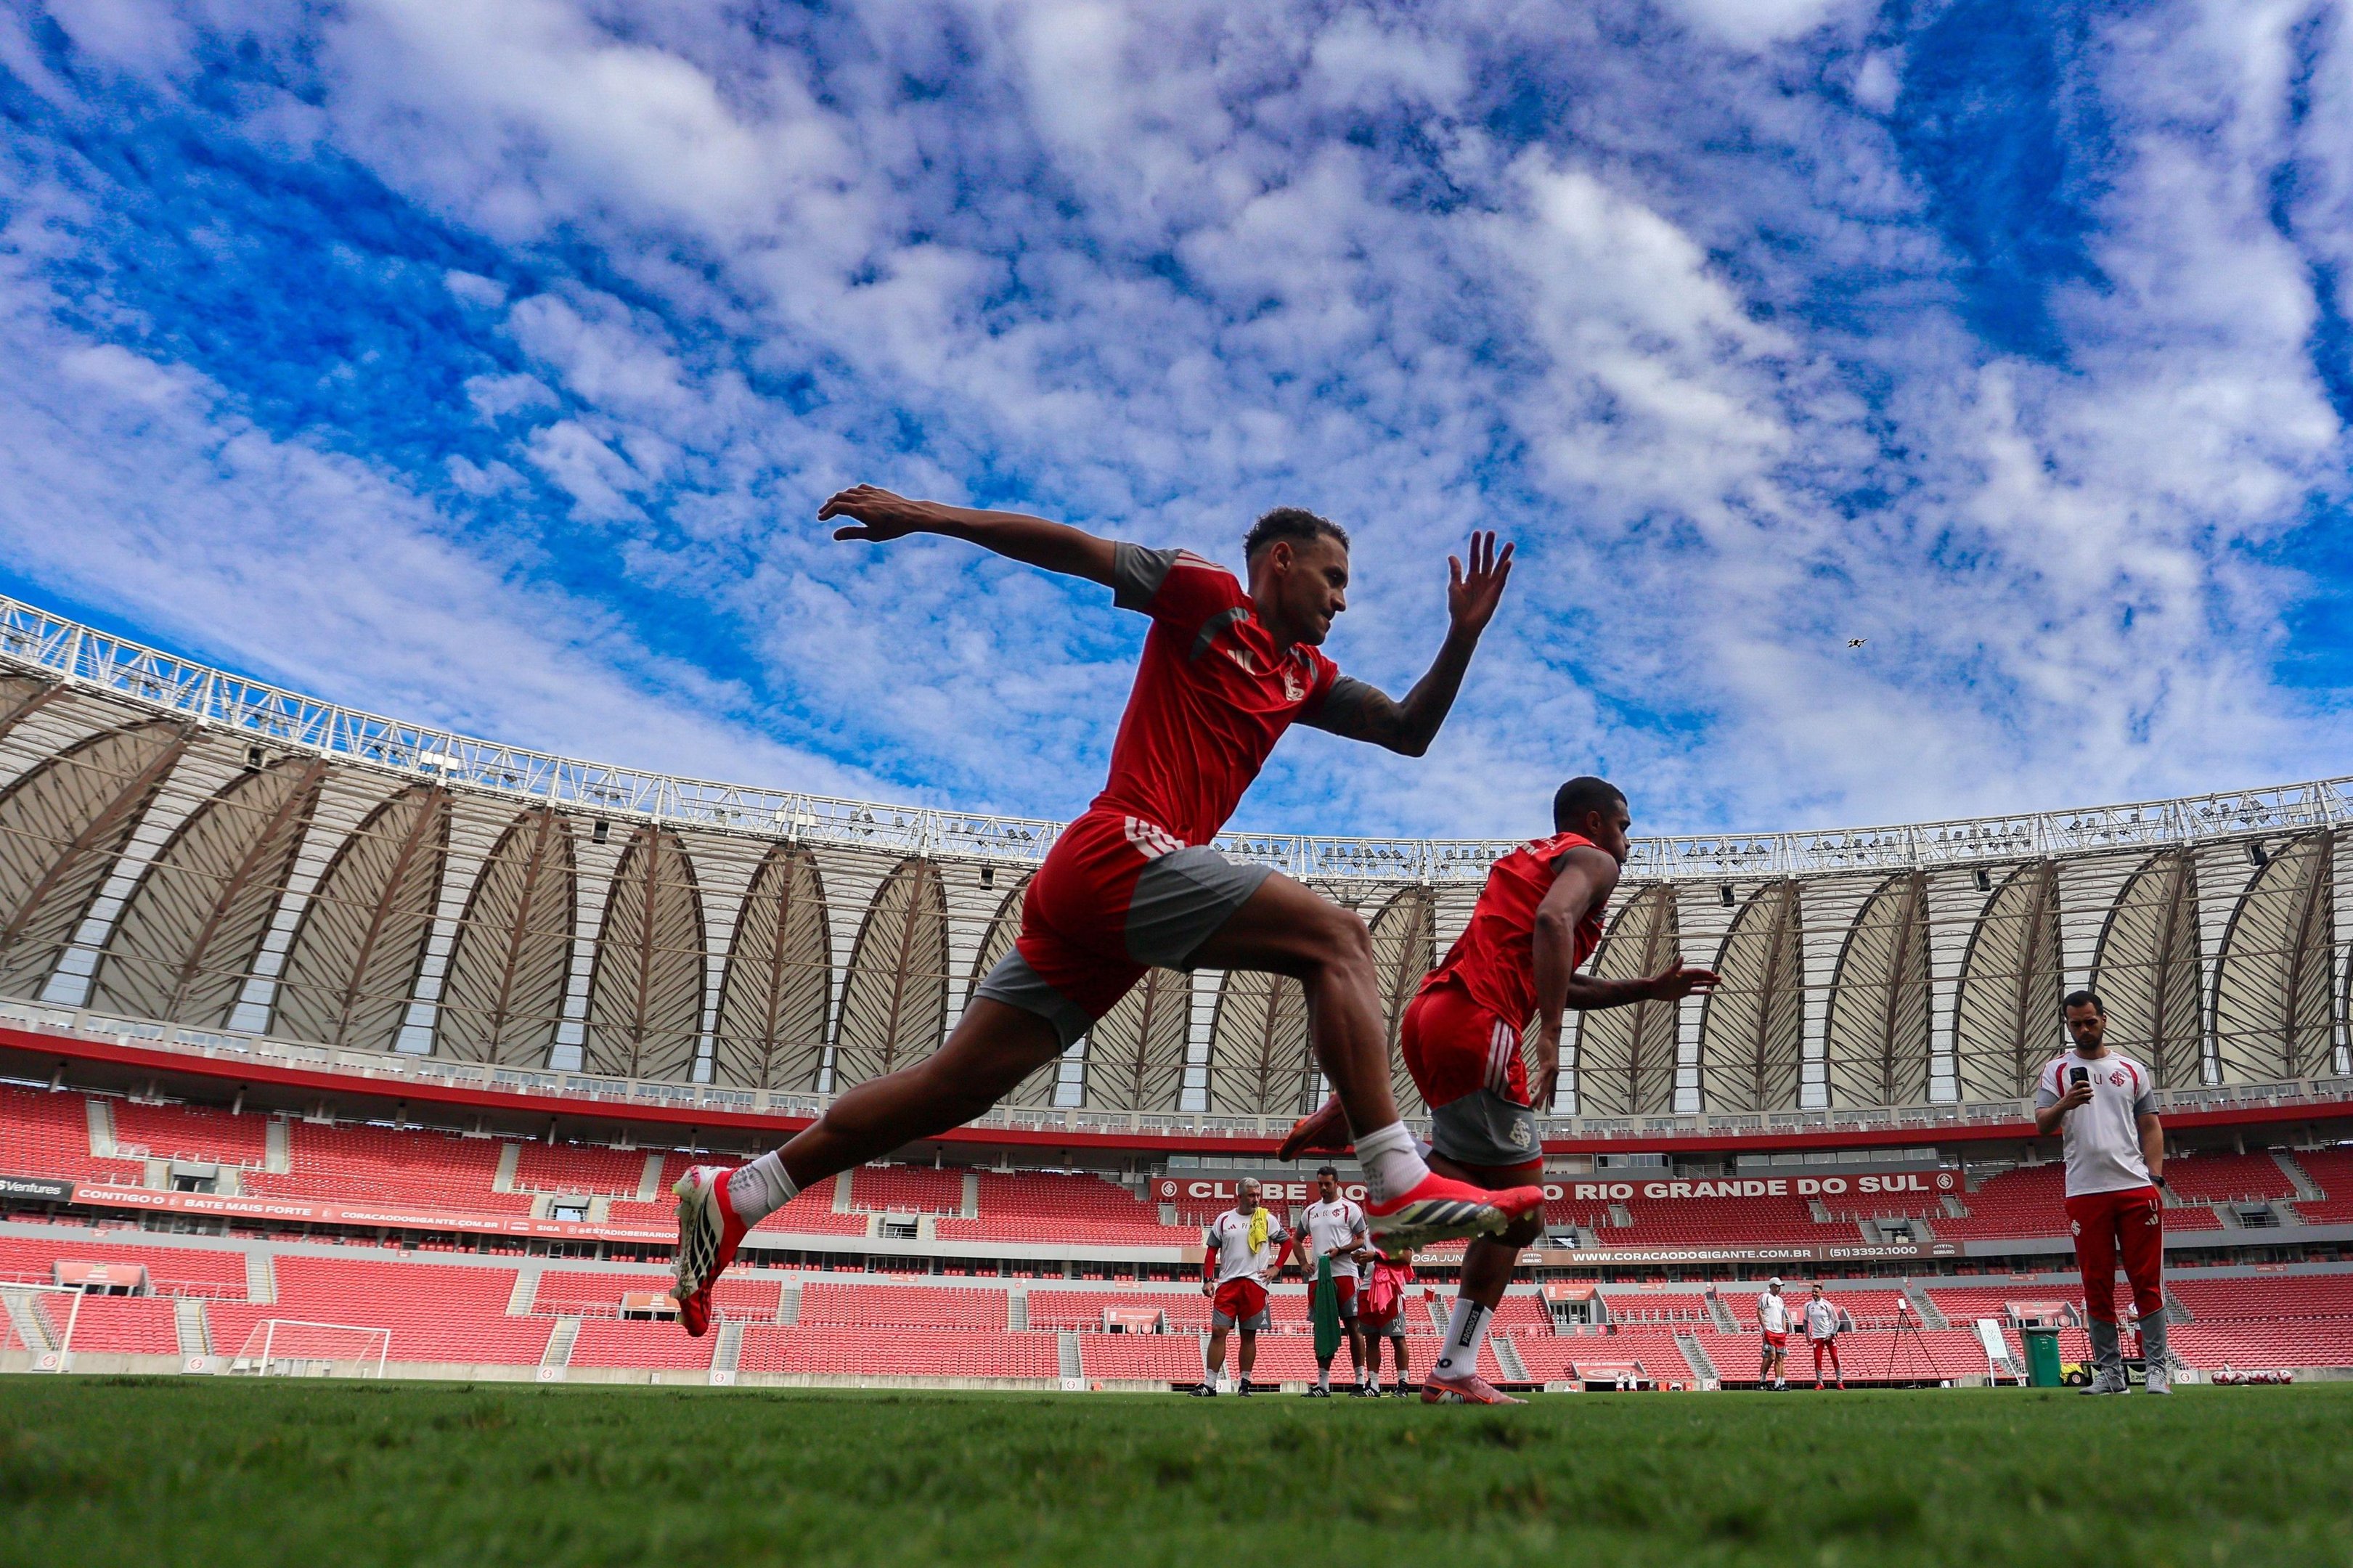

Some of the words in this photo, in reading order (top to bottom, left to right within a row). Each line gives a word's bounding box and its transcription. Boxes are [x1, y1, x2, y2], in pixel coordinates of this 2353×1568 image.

[1188, 1183, 1307, 1200] CLBE
[1337, 1185, 1369, 1201] O
[1575, 1183, 1634, 1200] RIO
[1644, 1180, 1787, 1199] GRANDE
[1797, 1177, 1848, 1195] DO
[1859, 1175, 1929, 1193] SUL
[78, 1189, 151, 1204] CONTIGO
[152, 1195, 165, 1204] O
[184, 1199, 224, 1210] BATE
[225, 1202, 263, 1213] MAIS
[264, 1205, 312, 1217] FORTE
[341, 1211, 499, 1229] CORACAODOGIGANTE.COM.BR
[536, 1224, 560, 1233] SIGA
[1573, 1249, 1811, 1262] WWW.CORACAODOGIGANTE.COM.BR
[1830, 1247, 1850, 1258] (51)
[1852, 1246, 1918, 1257] 3392.1000
[1462, 1310, 1479, 1344] PROSOCKS
